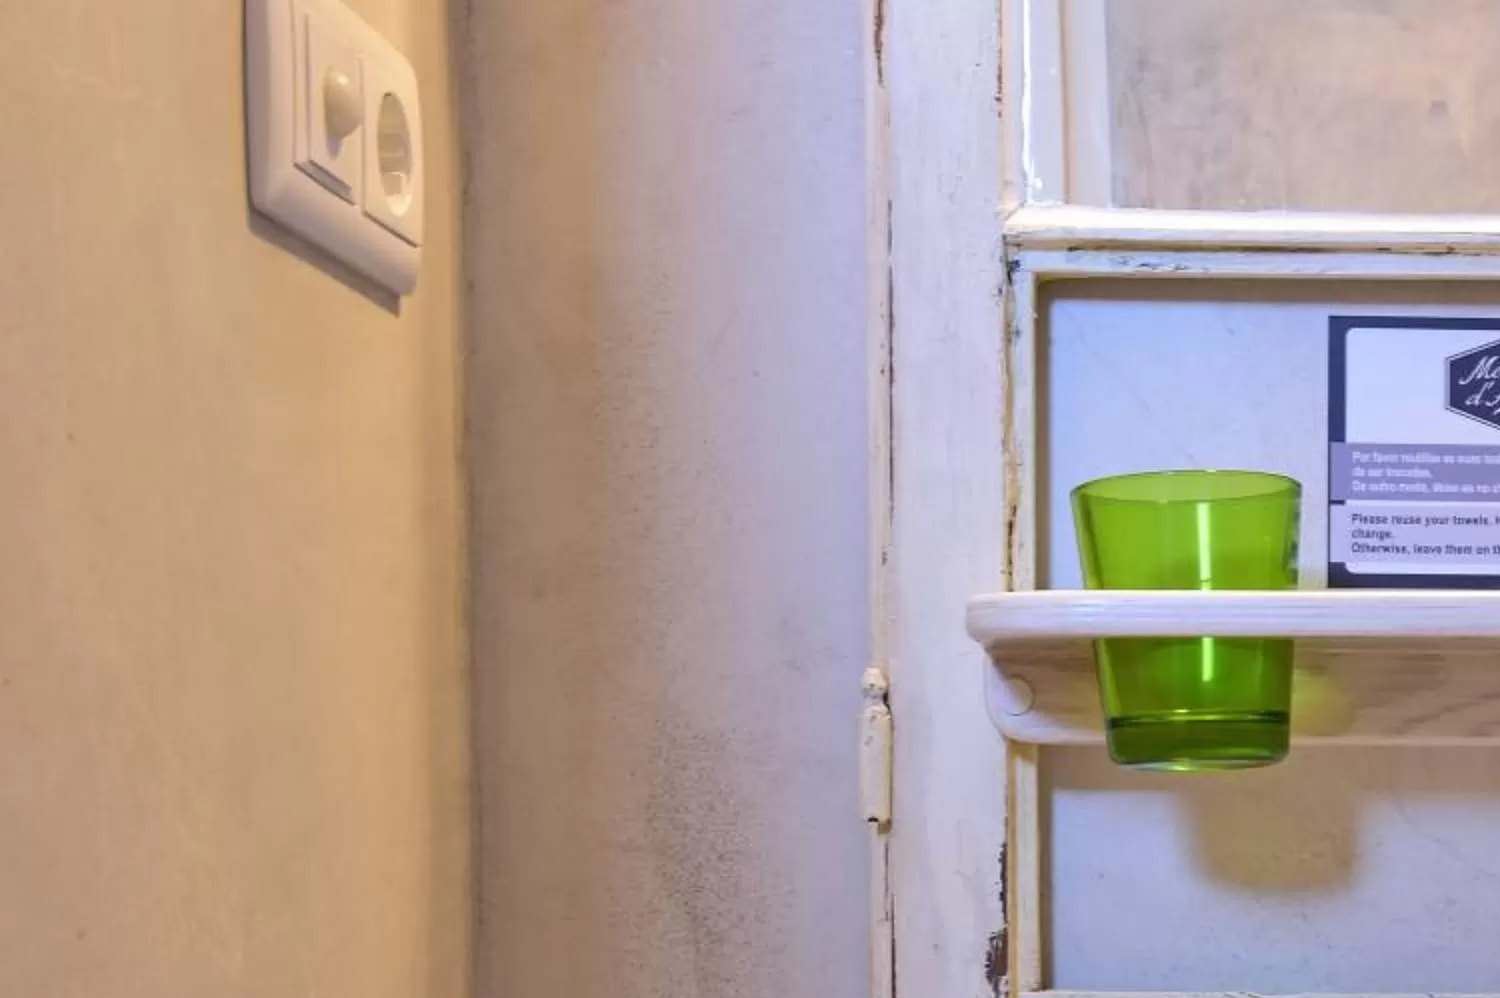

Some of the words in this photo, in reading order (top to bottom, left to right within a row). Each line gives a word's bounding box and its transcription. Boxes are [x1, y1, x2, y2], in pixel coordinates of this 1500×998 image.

[1352, 513, 1388, 525] Please
[1391, 515, 1421, 525] reuse
[1425, 516, 1449, 528] your
[1453, 514, 1492, 526] towels.
[1352, 529, 1395, 541] change.
[1352, 542, 1411, 555] Otherwise,
[1413, 543, 1442, 555] leave
[1445, 544, 1472, 555] them
[1475, 546, 1490, 555] on
